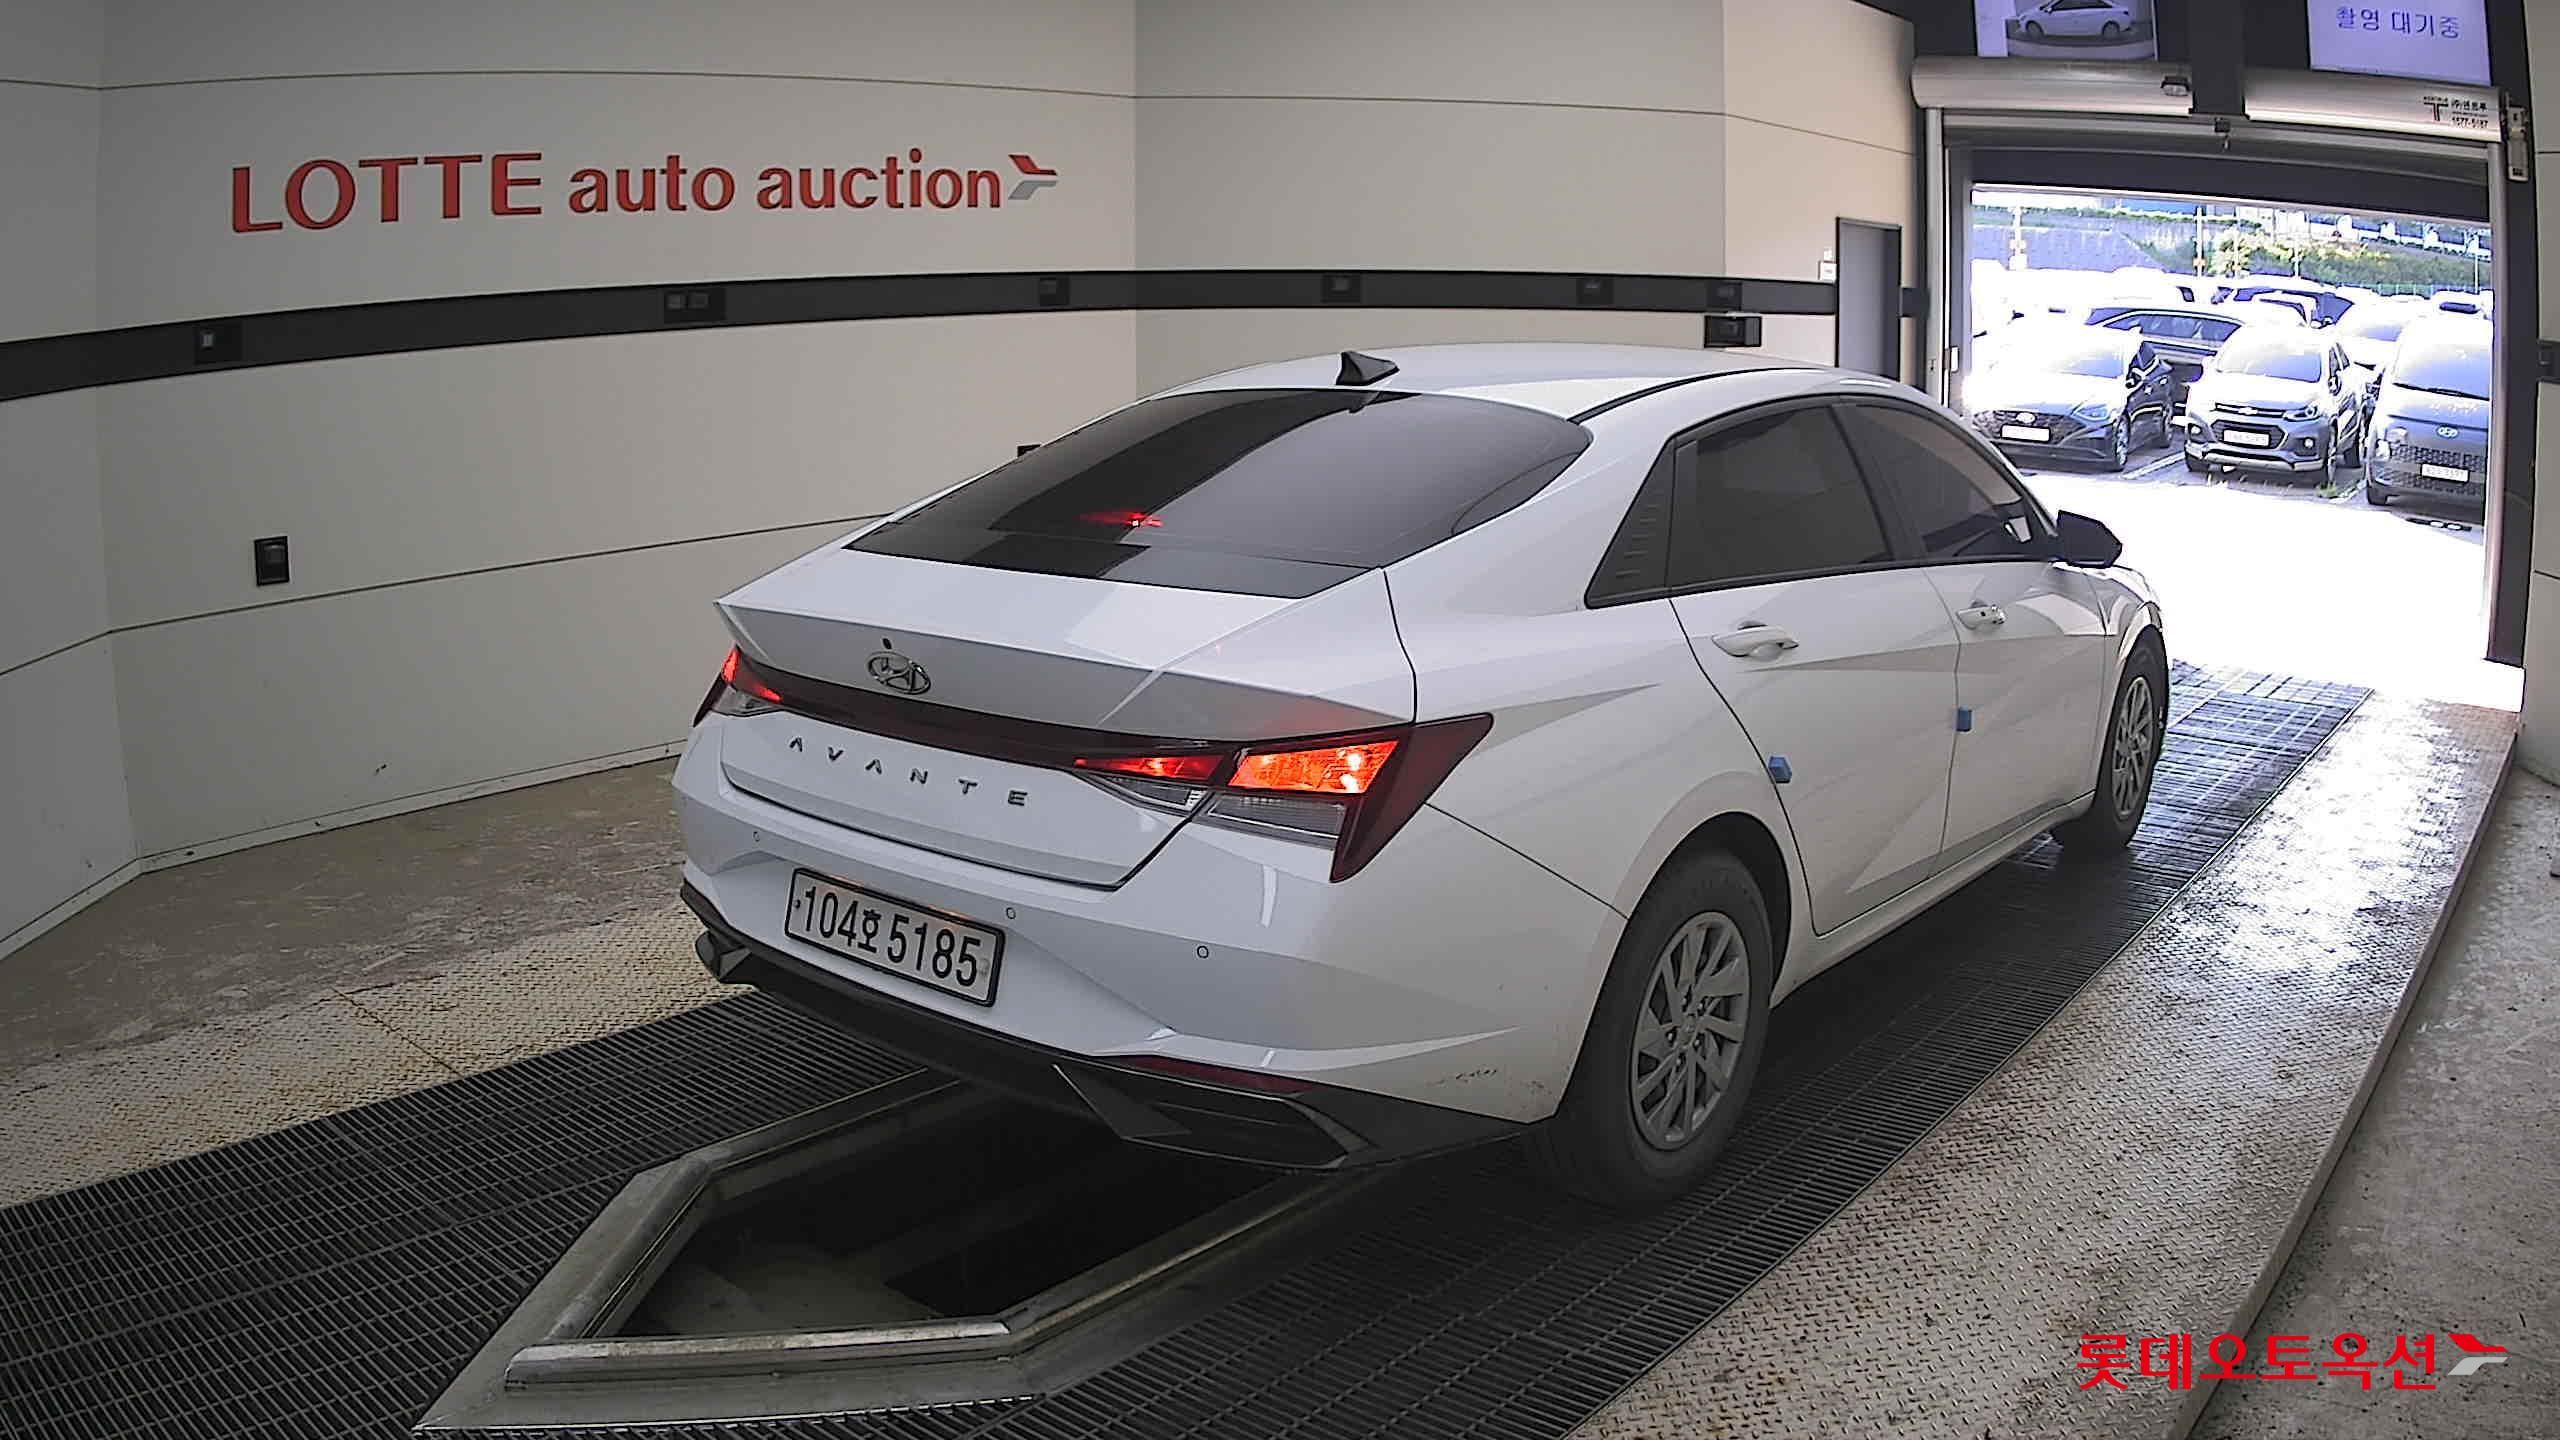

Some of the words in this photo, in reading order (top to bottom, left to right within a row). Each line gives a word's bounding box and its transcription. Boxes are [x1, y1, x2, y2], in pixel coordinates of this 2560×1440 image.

[2337, 6, 2380, 31] 촬영
[2391, 12, 2459, 39] 대기중
[233, 153, 542, 232] LOTTE
[569, 155, 735, 212] auto
[757, 149, 1001, 209] auction
[788, 736, 1028, 806] AVANTE
